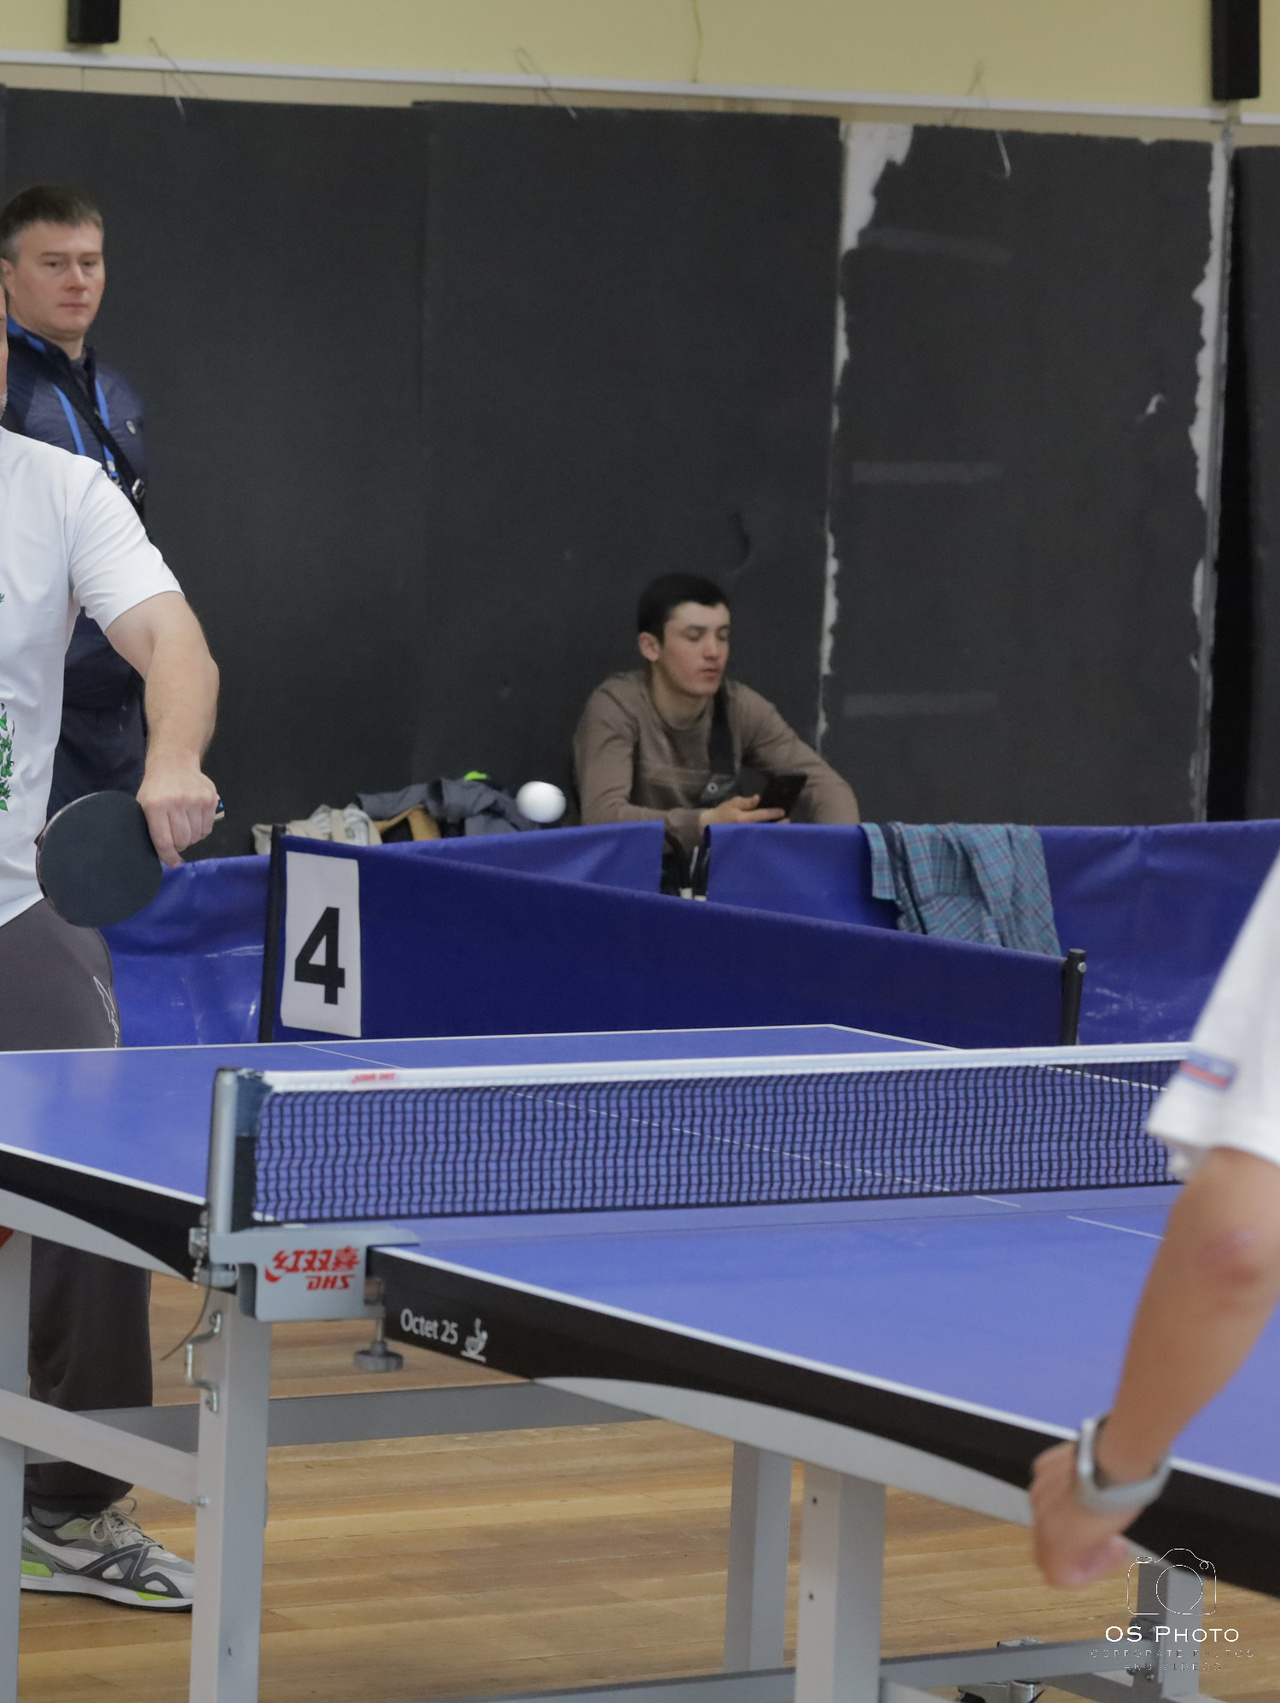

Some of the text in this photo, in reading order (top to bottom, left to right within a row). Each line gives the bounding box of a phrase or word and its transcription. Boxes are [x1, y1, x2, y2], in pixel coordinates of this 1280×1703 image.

[294, 906, 346, 1005] 4
[264, 1245, 360, 1283] 红双喜
[305, 1274, 356, 1291] DHS
[400, 1308, 459, 1345] Octet 25
